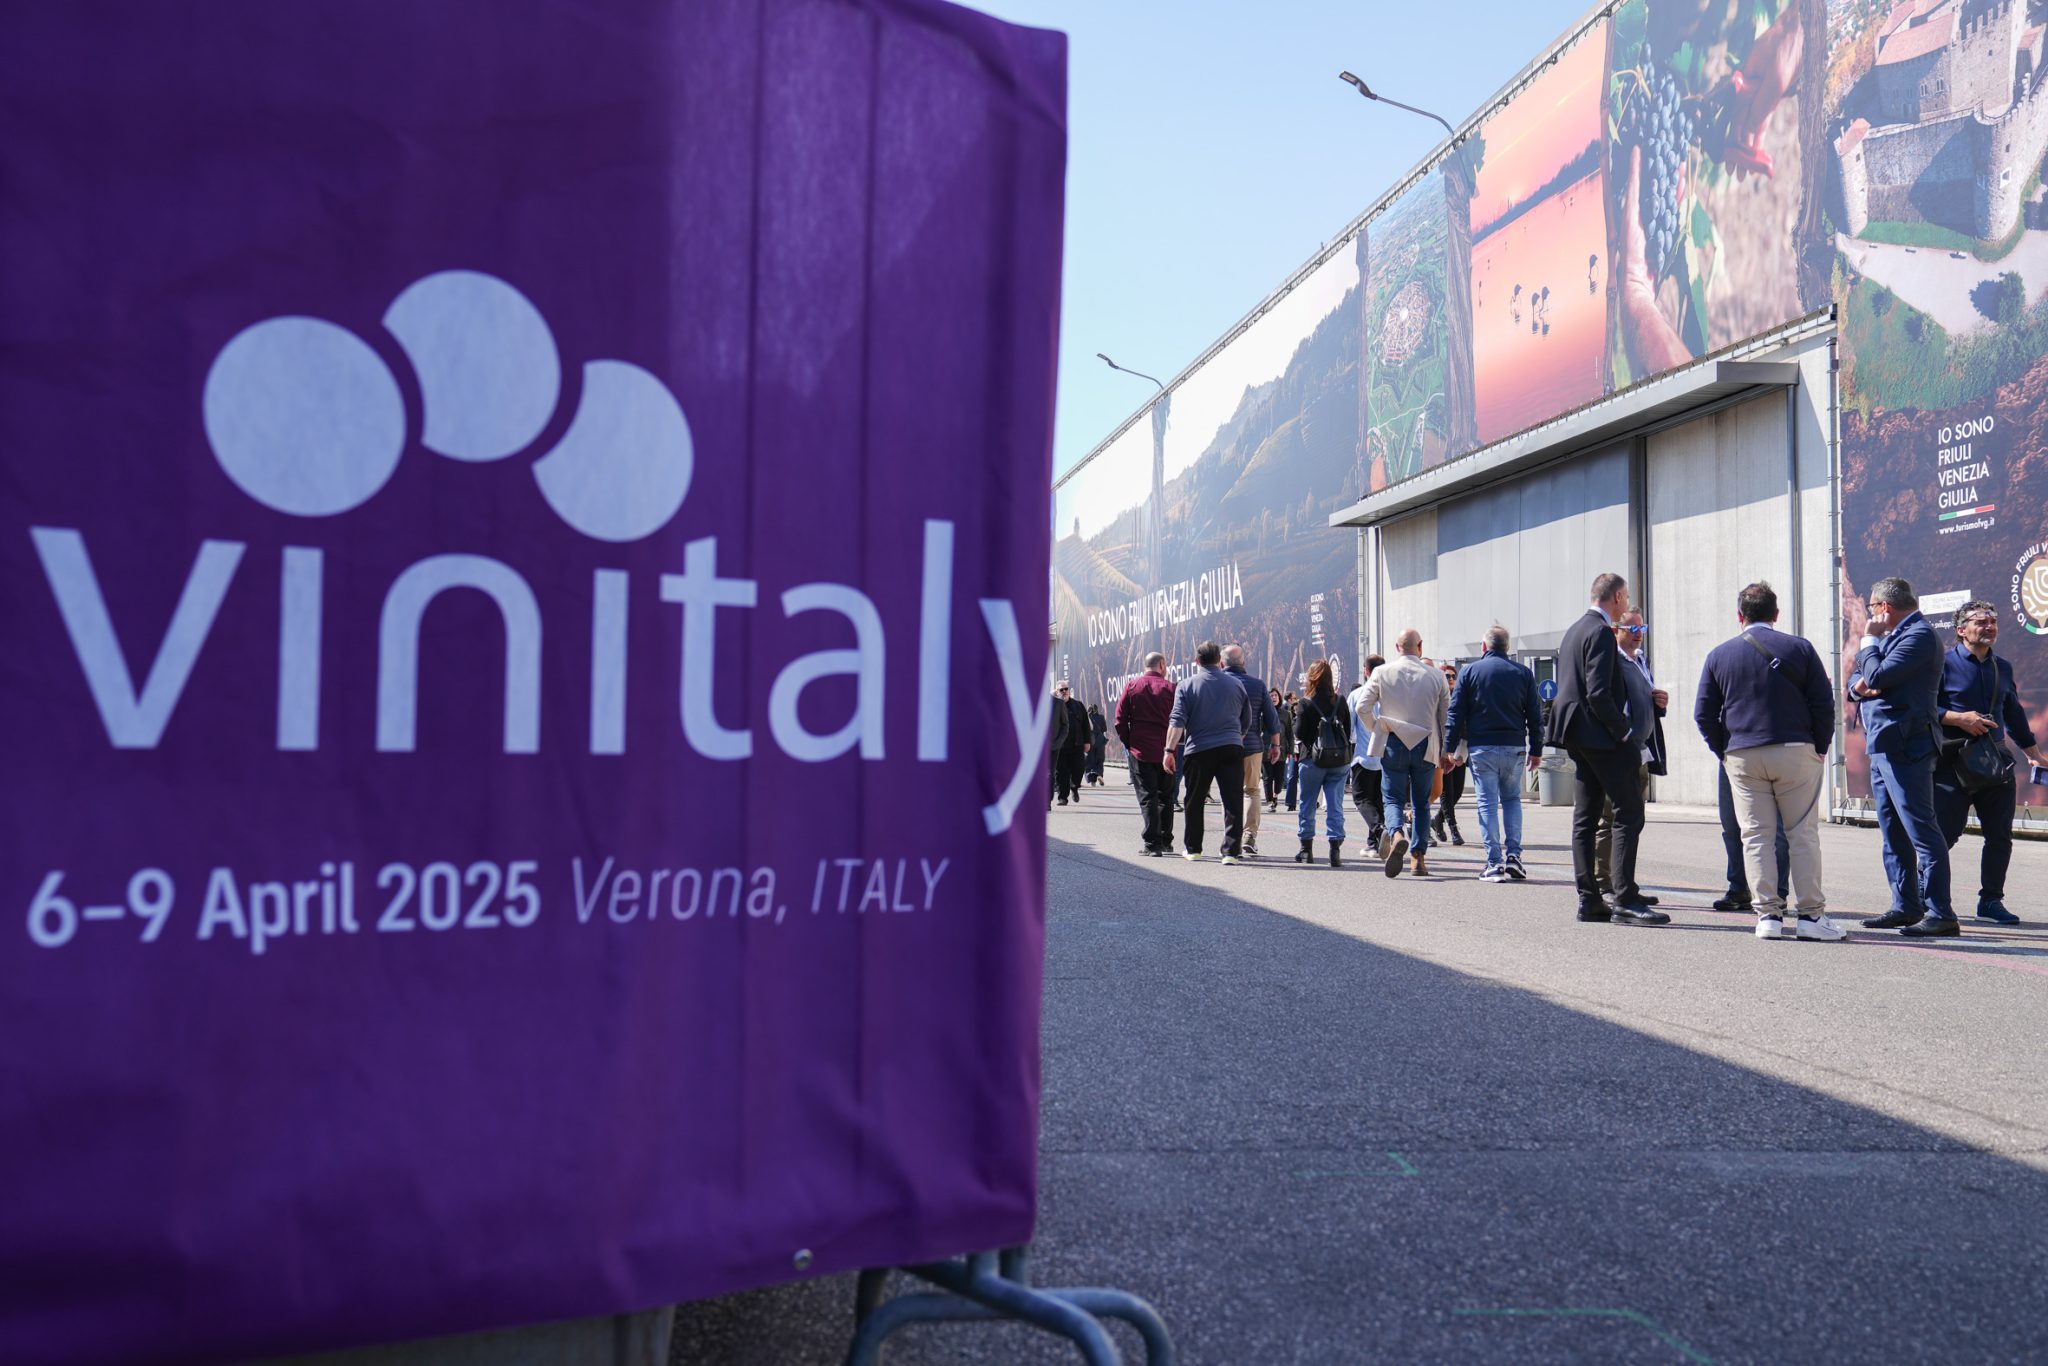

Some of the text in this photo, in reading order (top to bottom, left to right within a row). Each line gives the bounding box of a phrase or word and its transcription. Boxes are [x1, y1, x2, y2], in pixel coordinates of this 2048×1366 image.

[1938, 415, 1994, 445] IO SONO
[1938, 443, 1971, 466] FRIULI
[1938, 461, 1989, 488] VENEZIA
[1938, 486, 1978, 509] GIULIA
[1939, 517, 1995, 535] www.turismofvg.it
[2015, 543, 2040, 573] FRIULI
[1088, 560, 1244, 648] IO SONO FRIULI VENEZIA GIULIA
[2011, 574, 2021, 612] SONO
[30, 518, 1051, 836] vinitaly
[196, 861, 360, 956] April
[376, 860, 541, 932] 2025
[571, 855, 788, 926] Verona,
[811, 856, 951, 915] ITALY
